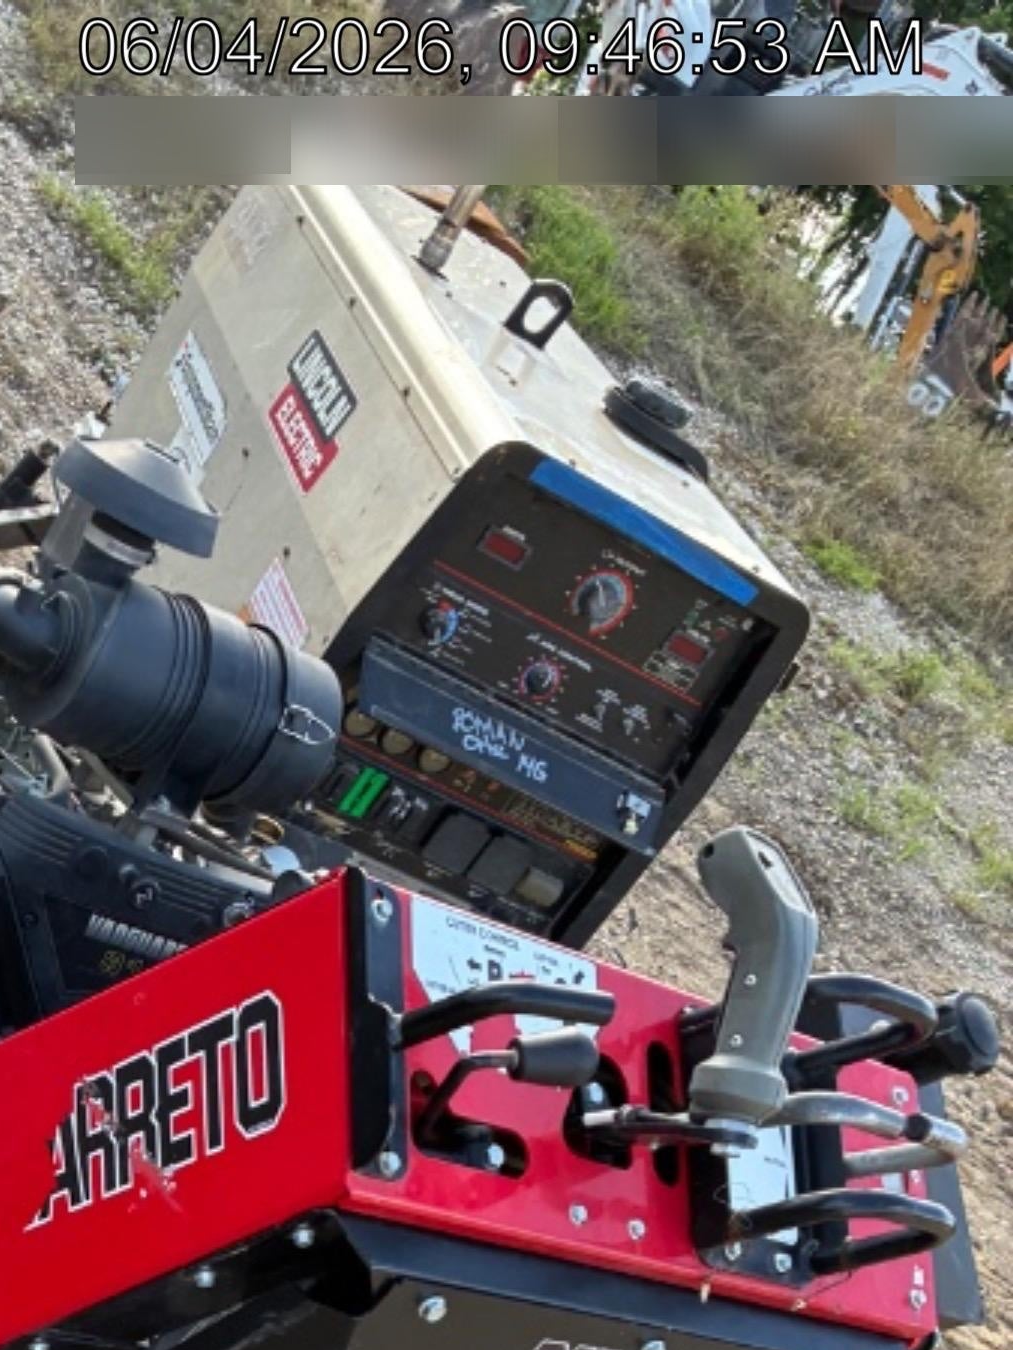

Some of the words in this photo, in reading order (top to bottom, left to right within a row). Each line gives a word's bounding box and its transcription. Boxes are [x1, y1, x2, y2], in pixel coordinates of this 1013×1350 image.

[274, 393, 324, 480] ELECTRIC
[290, 336, 353, 438] LINCOLN
[23, 989, 286, 1232] ARRETO
